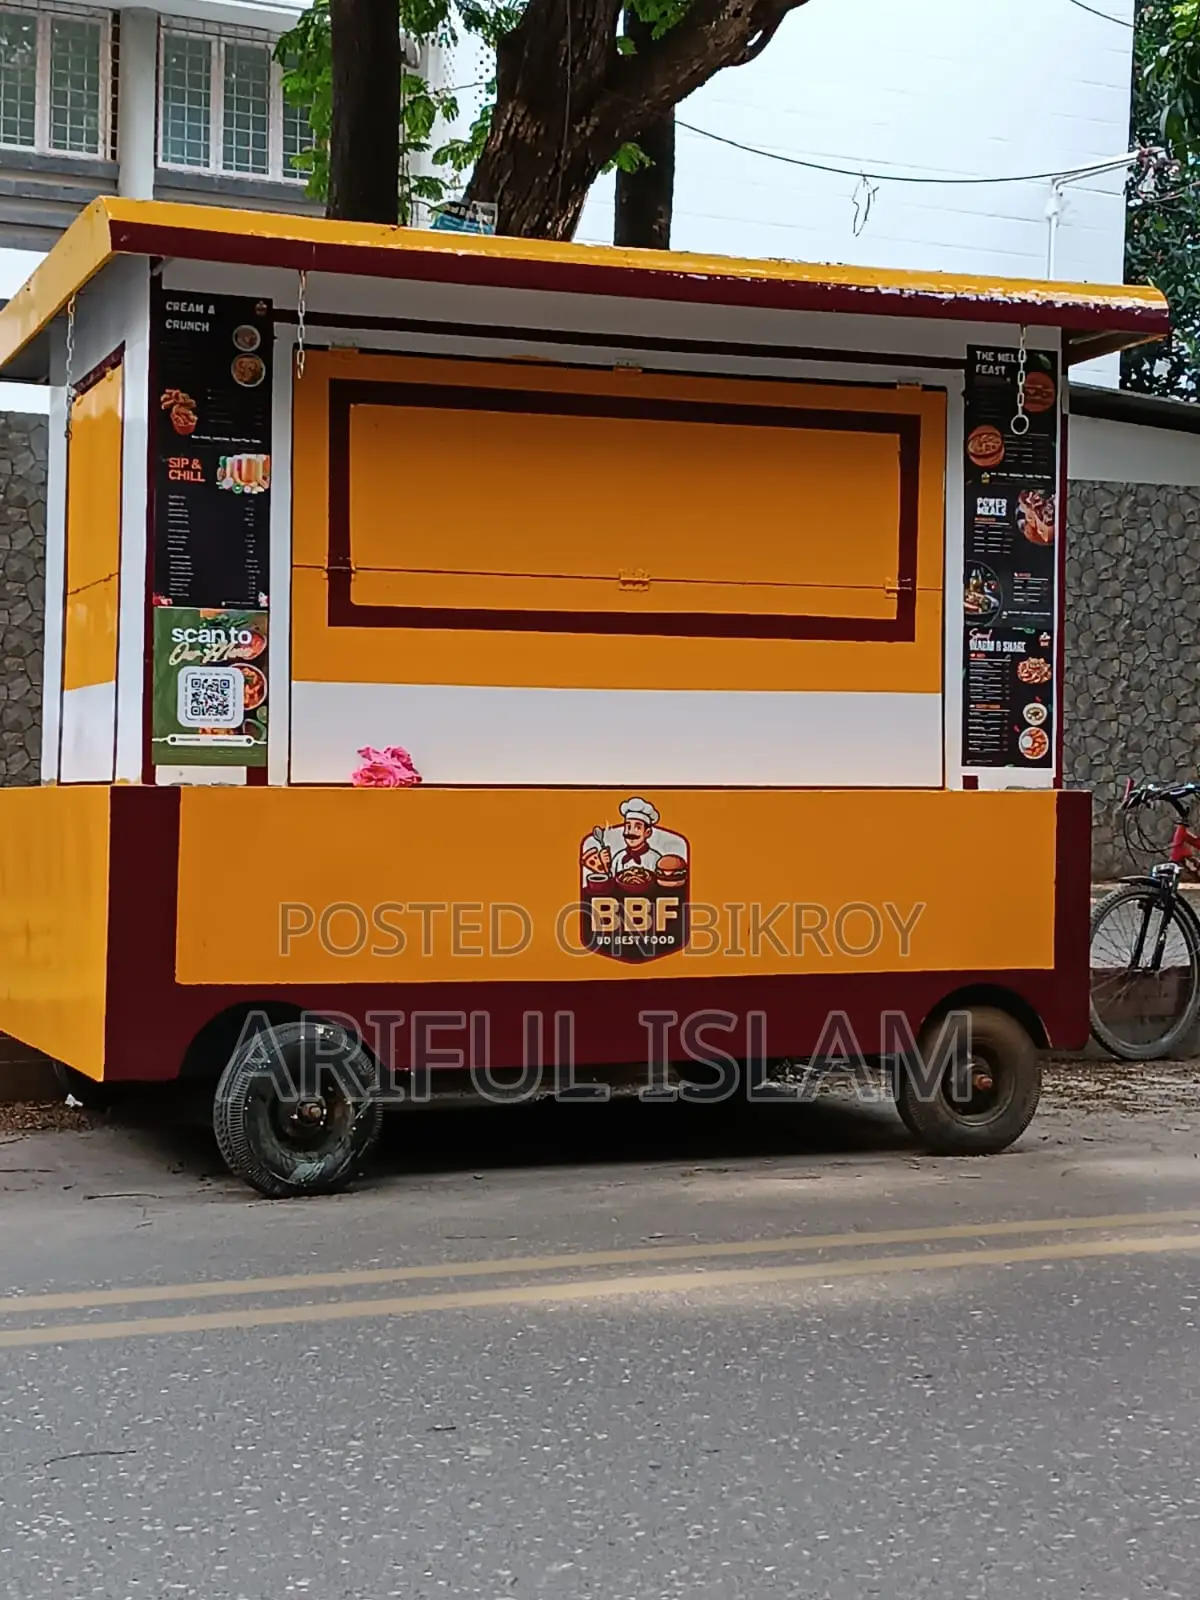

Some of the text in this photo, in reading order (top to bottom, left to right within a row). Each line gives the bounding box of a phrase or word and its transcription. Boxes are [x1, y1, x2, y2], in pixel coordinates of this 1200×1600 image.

[165, 301, 204, 314] CREAM
[165, 318, 210, 332] CRUNCH
[975, 350, 995, 361] THE
[975, 364, 1006, 375] FEAST
[168, 457, 202, 470] SIP &
[168, 469, 206, 483] CHILL
[171, 626, 253, 645] scan to
[591, 897, 680, 932] BBF
[615, 936, 640, 945] BEST
[643, 936, 675, 945] FOOD
